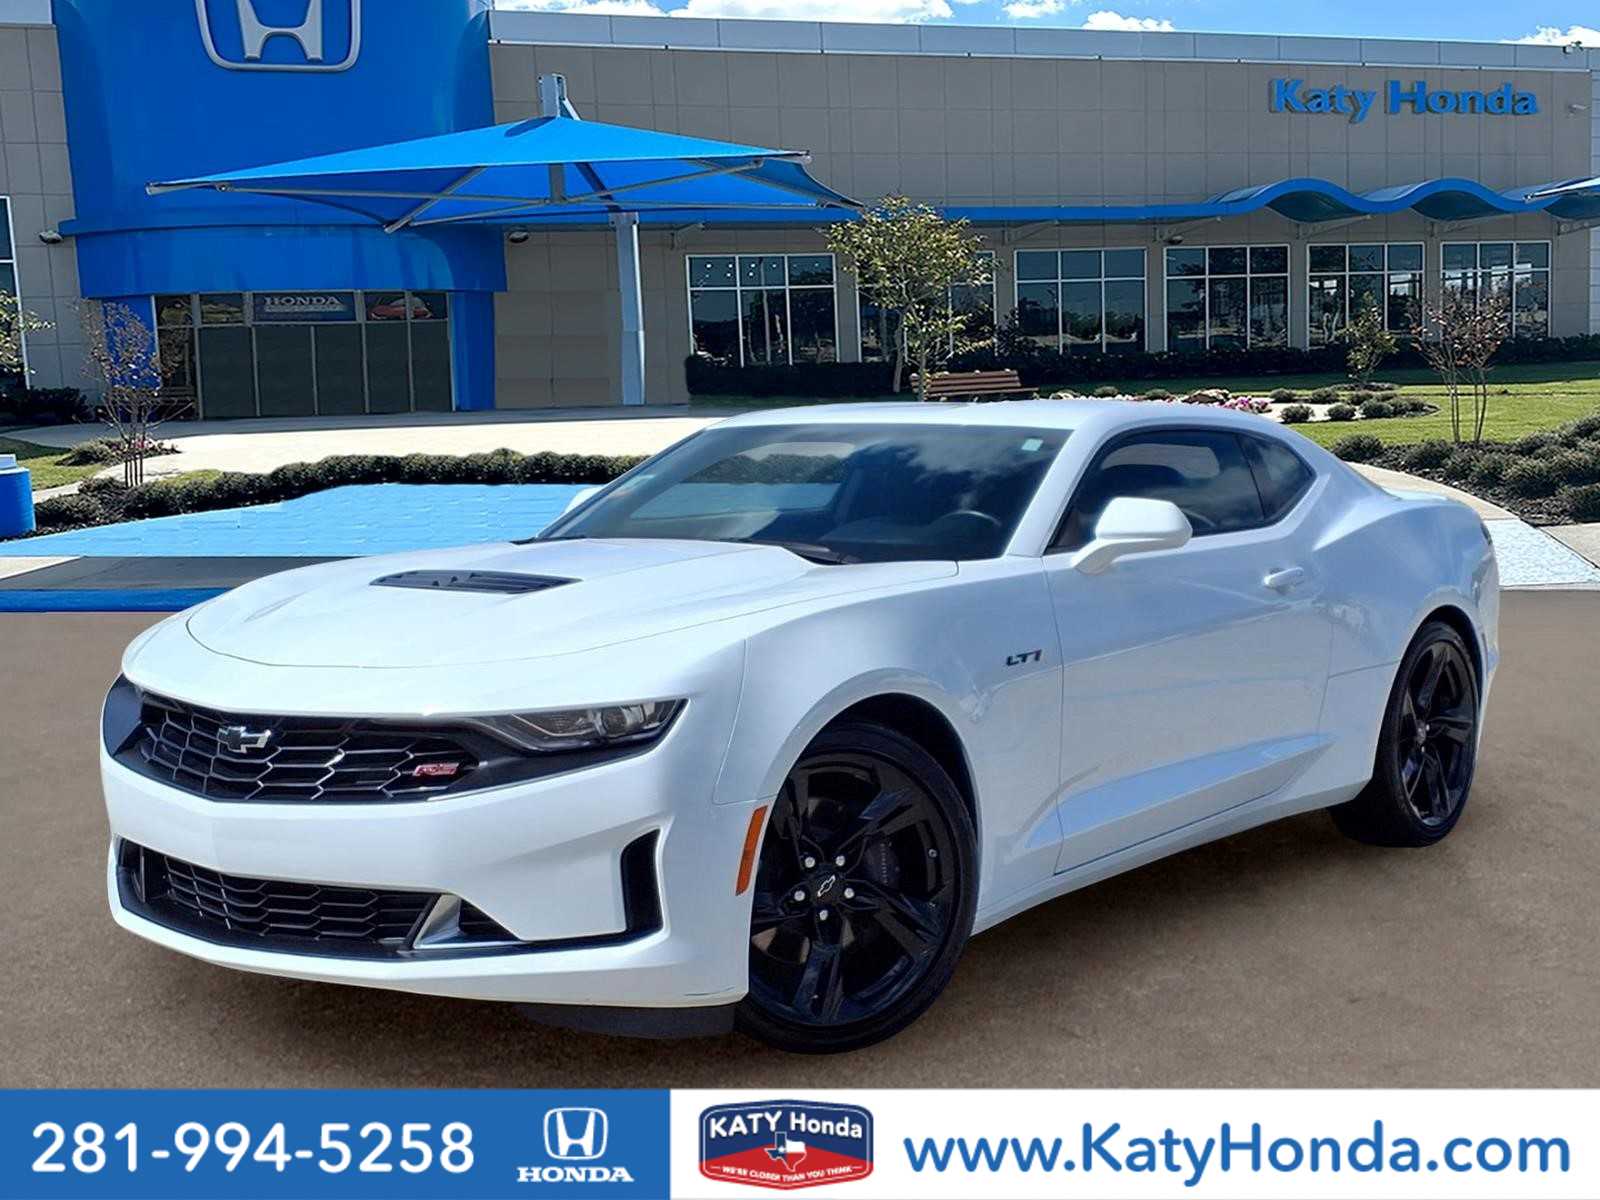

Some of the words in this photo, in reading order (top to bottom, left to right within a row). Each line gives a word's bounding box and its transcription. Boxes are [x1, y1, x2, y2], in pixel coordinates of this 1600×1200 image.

[1270, 78, 1377, 124] Katy
[1385, 80, 1540, 116] Honda
[264, 296, 342, 305] HONDA
[414, 762, 459, 776] RS
